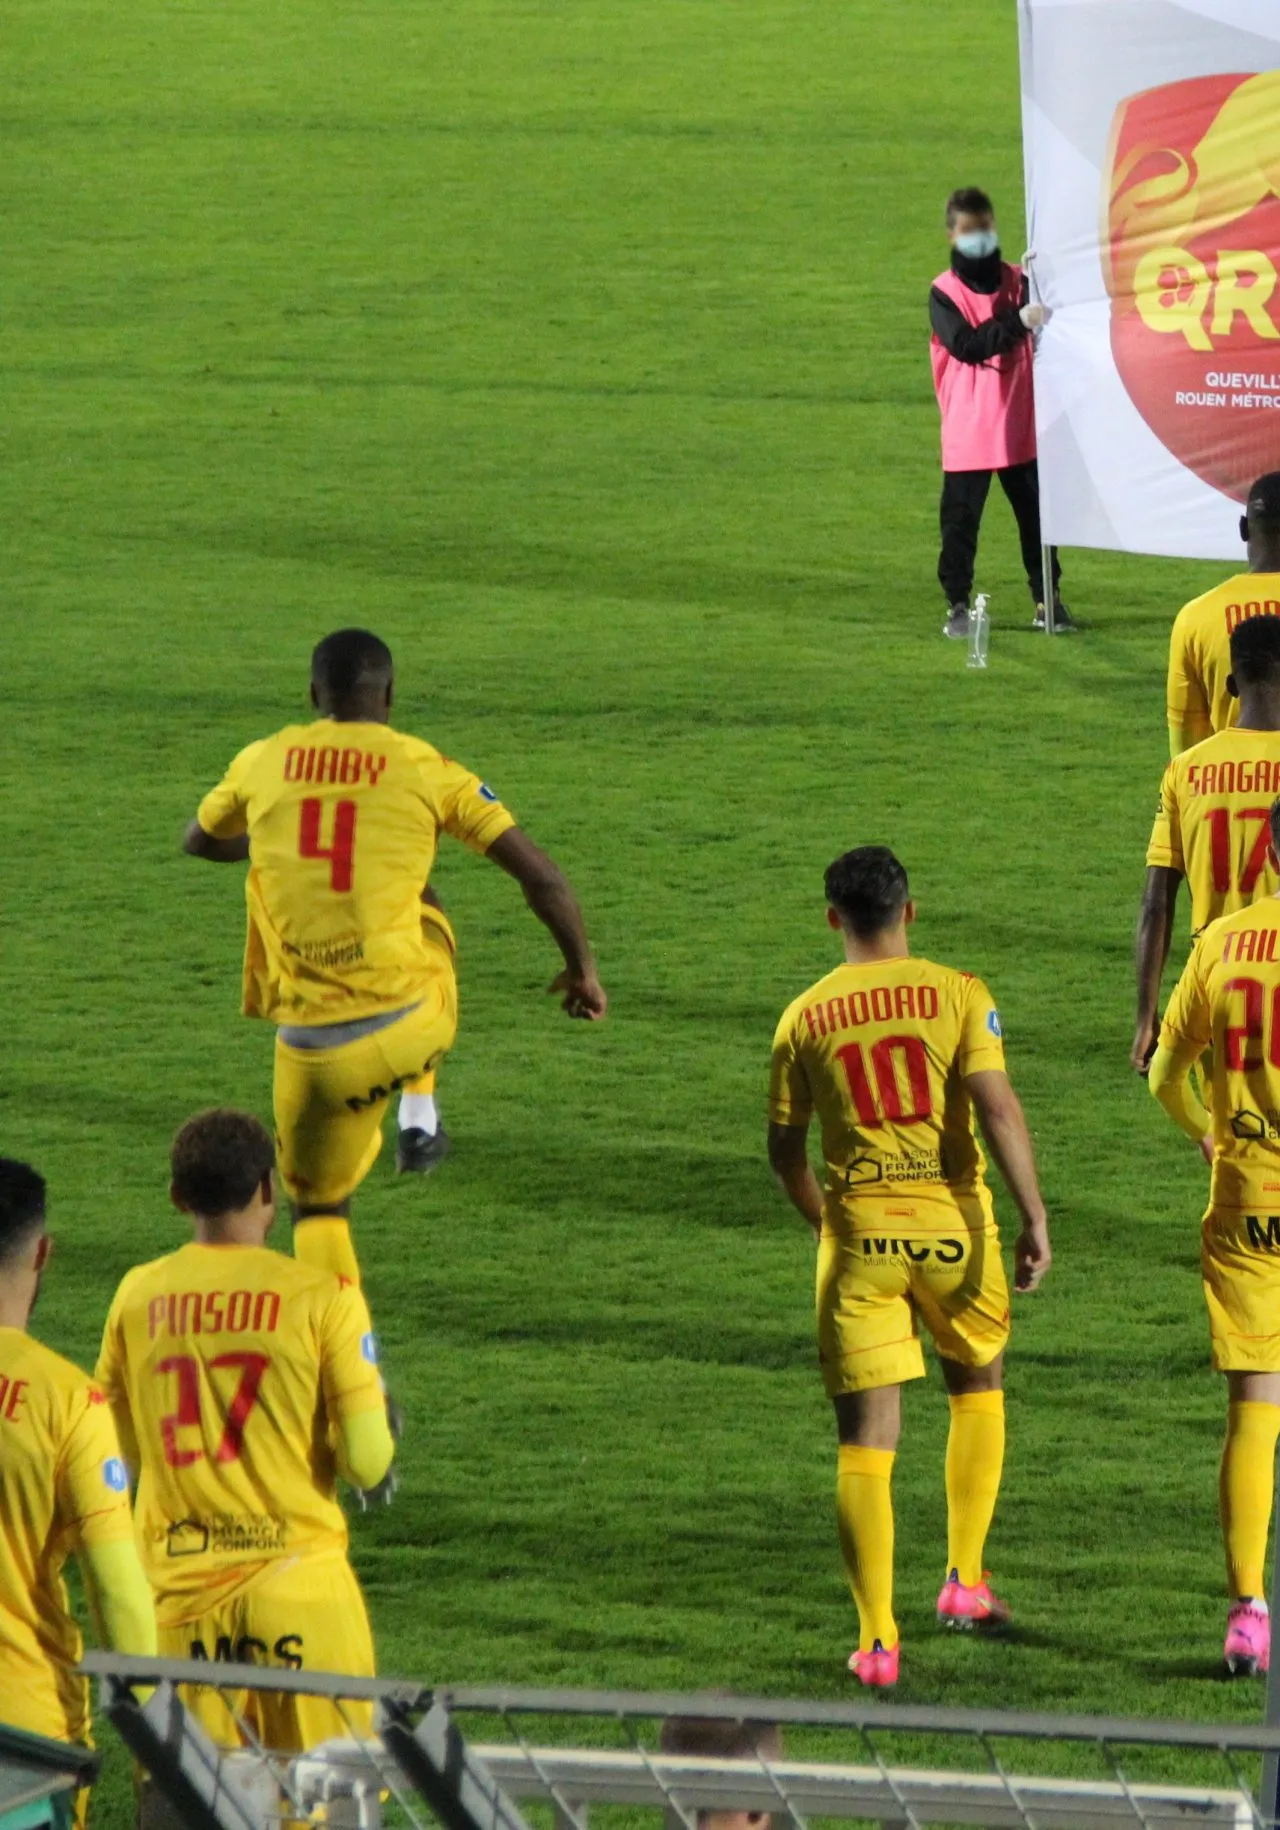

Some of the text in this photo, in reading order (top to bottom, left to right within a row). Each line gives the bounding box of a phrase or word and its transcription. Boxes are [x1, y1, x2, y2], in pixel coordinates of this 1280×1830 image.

[1175, 391, 1226, 407] ROUEN
[283, 747, 387, 786] DIABY
[299, 796, 358, 893] 4
[1203, 806, 1273, 894] 17
[803, 985, 939, 1040] HADDAD
[833, 1035, 932, 1130] 10
[886, 1159, 940, 1171] FRANC
[886, 1171, 944, 1181] CONFOR
[148, 1291, 281, 1338] PINSON
[156, 1351, 272, 1468] 27
[190, 1635, 304, 1670] MCS
